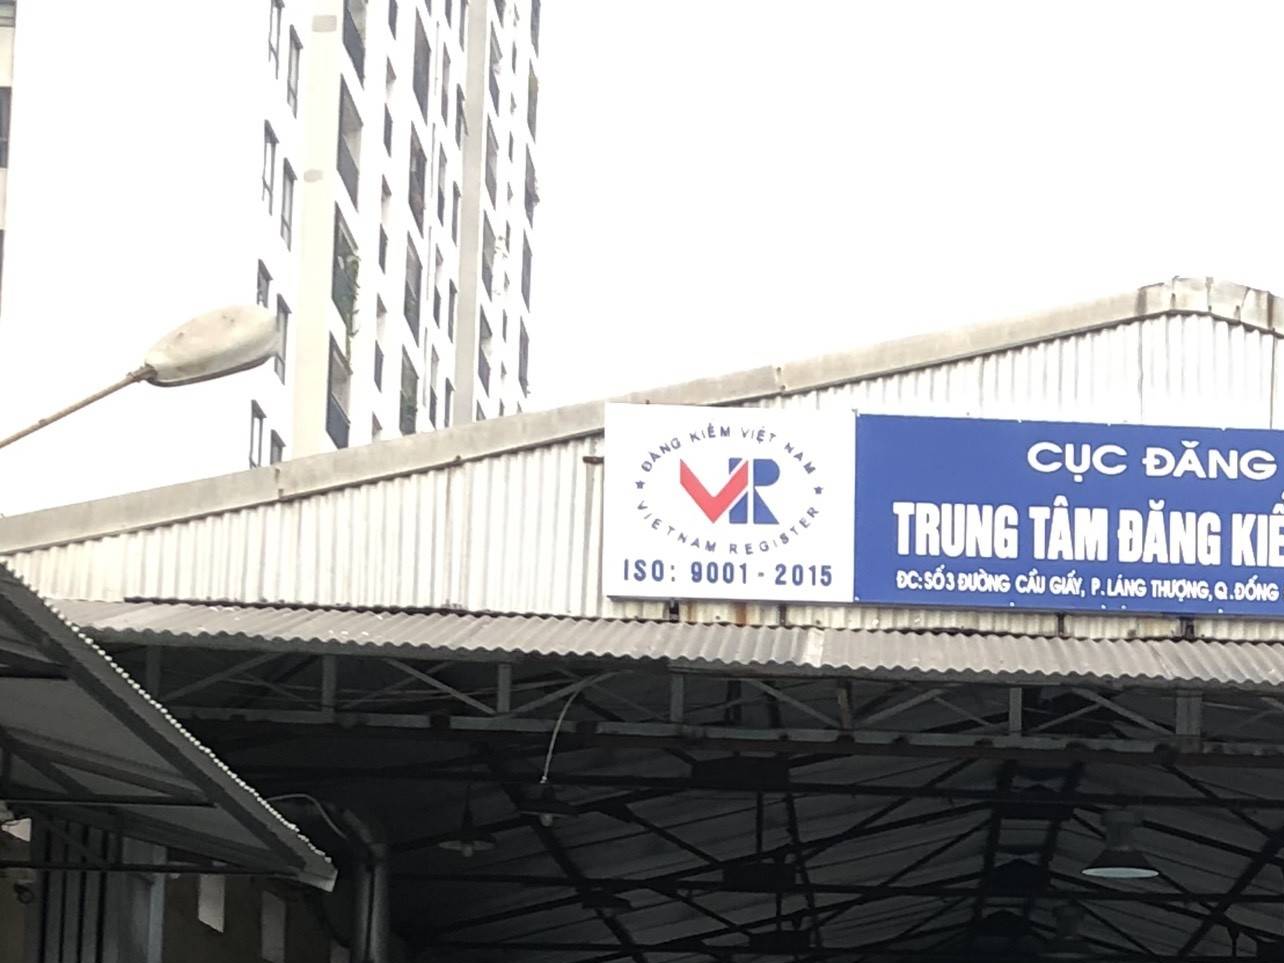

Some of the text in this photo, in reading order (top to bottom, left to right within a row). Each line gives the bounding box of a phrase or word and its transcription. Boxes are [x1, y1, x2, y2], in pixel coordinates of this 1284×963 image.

[785, 442, 816, 475] NAM
[1026, 441, 1127, 483] CỤC
[1142, 440, 1278, 481] ĐĂNG
[636, 500, 820, 556] VIETNAM REGISTER
[892, 501, 1020, 560] TRUNG
[1028, 495, 1109, 562] TÂM
[1116, 498, 1222, 566] ĐĂNG
[690, 561, 747, 585] 9001
[774, 563, 833, 587] 2015
[957, 568, 1011, 593] ĐƯỜNG
